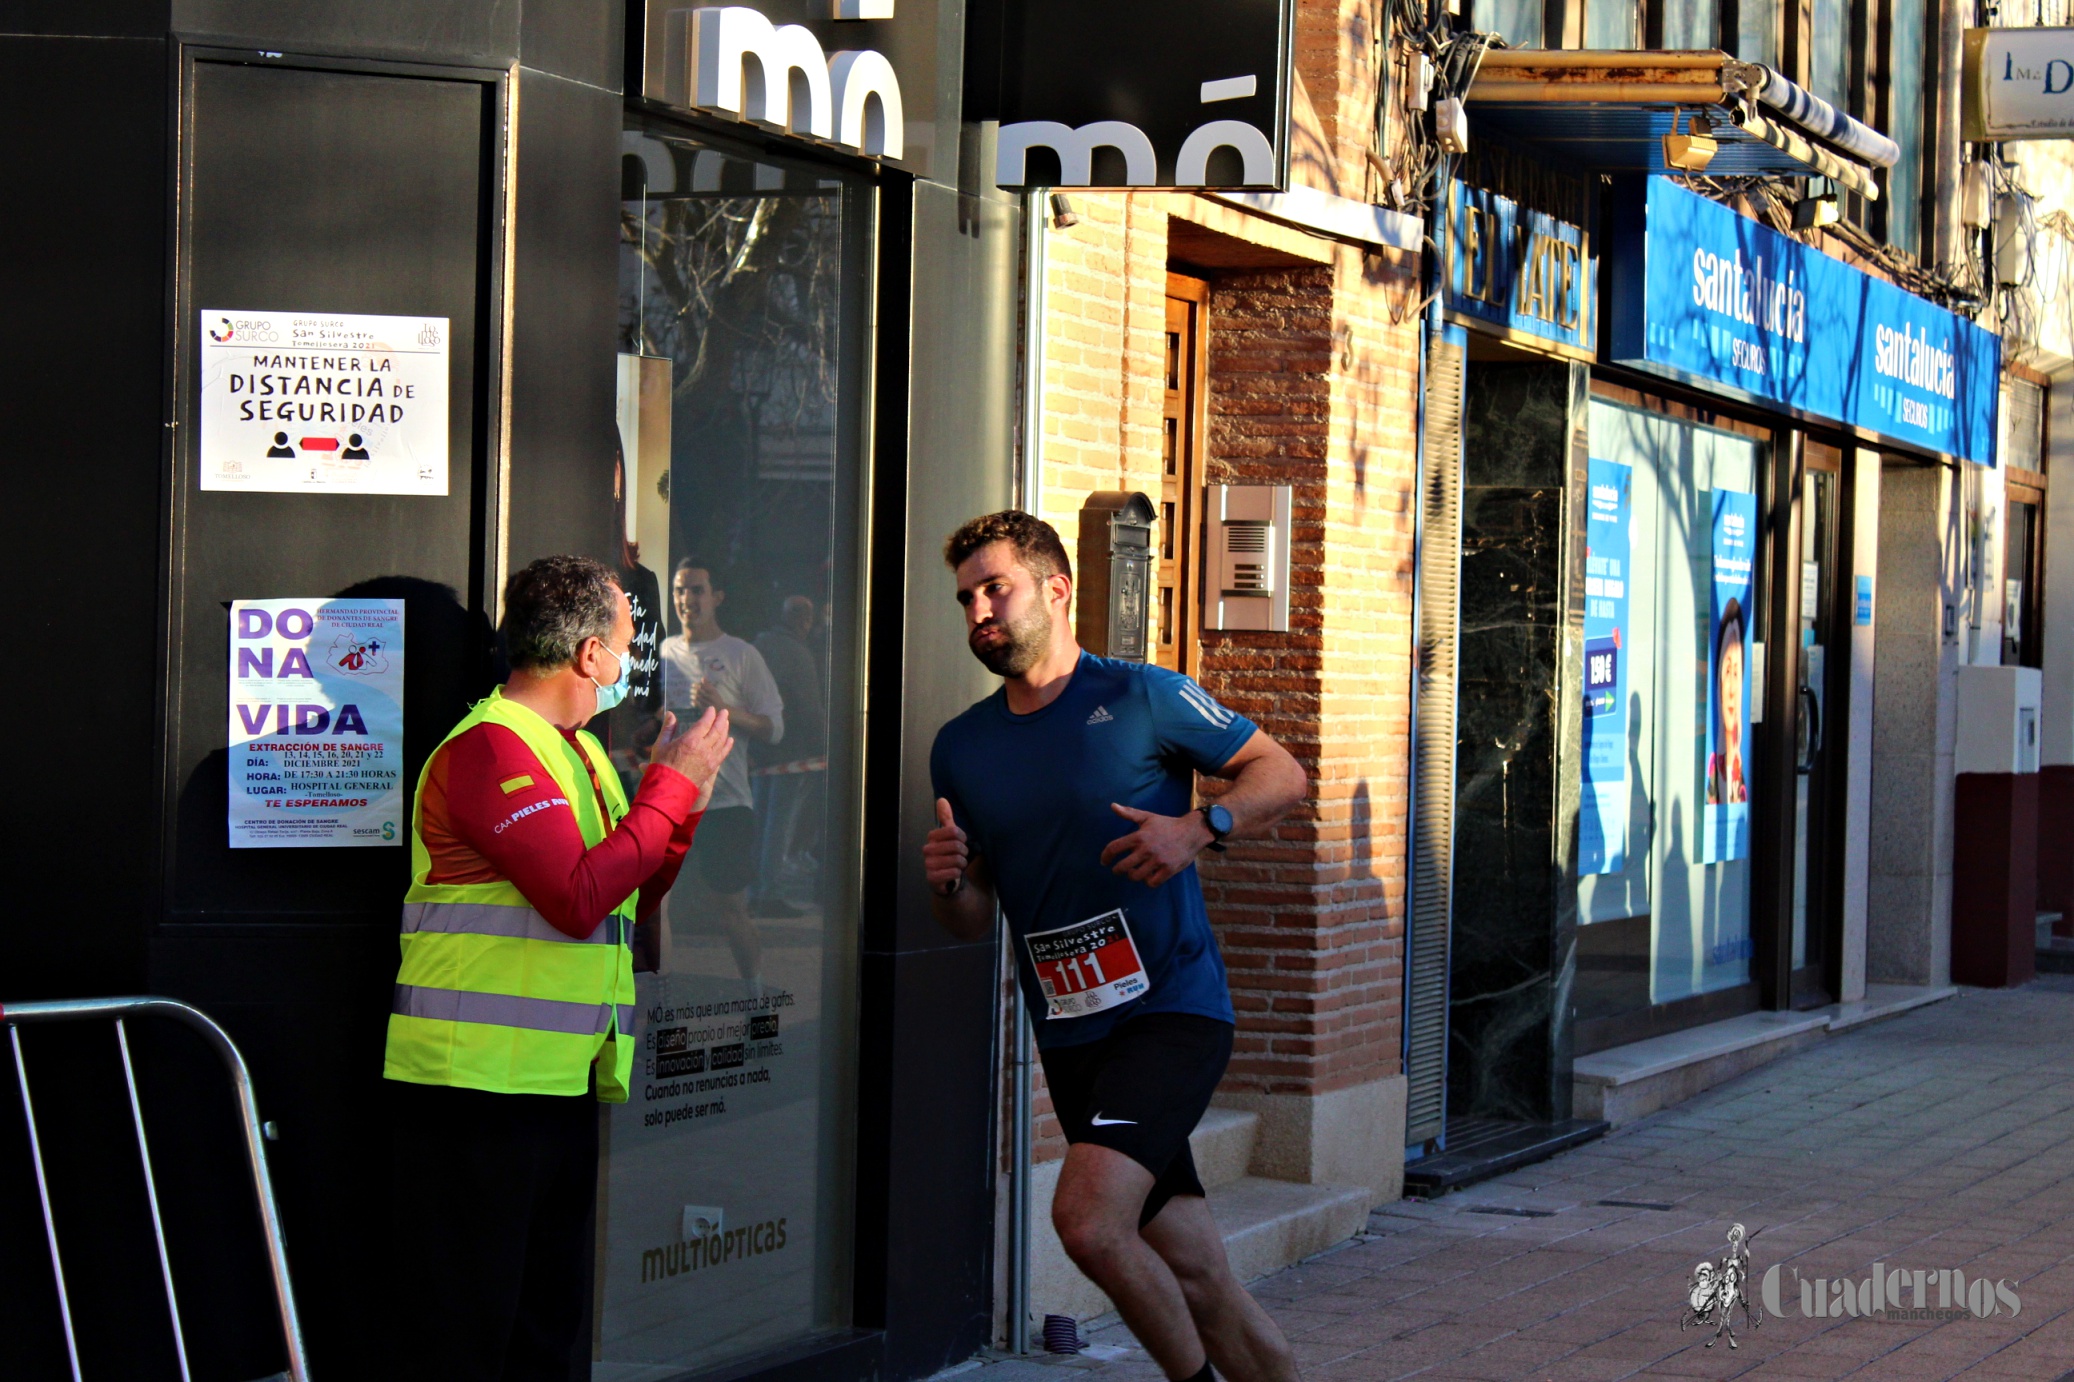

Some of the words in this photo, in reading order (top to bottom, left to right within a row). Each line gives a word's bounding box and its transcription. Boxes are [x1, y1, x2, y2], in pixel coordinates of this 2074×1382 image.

[1462, 205, 1506, 309] EL
[1513, 224, 1580, 331] YATE
[1692, 247, 1805, 344] santalucía
[235, 320, 271, 331] GRUPO
[235, 330, 280, 343] SURCO
[292, 328, 314, 338] San
[319, 329, 375, 340] Silvestre
[292, 340, 349, 349] Tomellosera
[352, 342, 376, 350] 2021
[1732, 337, 1767, 376] SEGUROS
[253, 355, 361, 371] MANTENER
[370, 358, 392, 372] LA
[1874, 321, 1955, 400] santalucía
[230, 374, 384, 397] DISTANCIA
[393, 384, 416, 399] DE
[240, 400, 404, 423] SEGURIDAD
[1902, 397, 1929, 429] SEGUROS
[238, 608, 314, 640] DO
[238, 647, 314, 679] NA
[236, 704, 369, 736] VIDA
[1086, 714, 1114, 726] adidas
[249, 742, 320, 752] EXTRACCIÓN
[323, 743, 337, 751] DE
[340, 743, 384, 751] SANGRE
[366, 752, 371, 761] y
[374, 751, 384, 759] 22
[246, 757, 269, 767] DÍA:
[284, 759, 340, 768] DICIEMBRE
[342, 759, 361, 768] 2021
[284, 771, 298, 779] DE
[301, 771, 324, 779] 17:30
[325, 771, 333, 779] A
[335, 771, 359, 779] 21:30
[361, 770, 397, 779] HORAS
[246, 772, 281, 781] HORA:
[291, 782, 342, 791] HOSPITAL
[344, 782, 394, 790] GENERAL
[246, 786, 287, 795] LUGAR:
[265, 799, 281, 807] TE
[285, 798, 368, 807] ESPERAMOS
[494, 818, 513, 834] CAA
[511, 800, 551, 822] PIELES
[1033, 942, 1052, 954] San
[1053, 925, 1116, 950] Silvestre
[1036, 944, 1087, 963] Tomellosera
[1089, 934, 1121, 950] 2021
[1055, 952, 1107, 993] 111
[1113, 977, 1138, 991] Pieles
[647, 1006, 663, 1024] MÓ
[664, 1008, 675, 1022] es
[676, 1002, 695, 1021] más
[696, 1003, 712, 1022] que
[714, 1002, 730, 1015] una
[731, 998, 758, 1013] marca
[760, 993, 770, 1010] de
[771, 990, 796, 1012] gafas.
[646, 1032, 656, 1050] Es
[658, 1029, 687, 1050] diseño
[688, 1025, 716, 1046] propio
[716, 1023, 726, 1040] al
[726, 1020, 750, 1041] mejor
[646, 1059, 656, 1076] Es
[656, 1051, 704, 1076] innovación
[711, 1046, 743, 1068] calidad
[744, 1045, 756, 1061] sin
[645, 1080, 680, 1101] Cuando
[682, 1083, 694, 1096] no
[695, 1071, 738, 1093] renuncias
[739, 1074, 745, 1085] a
[746, 1066, 771, 1084] nada,
[644, 1109, 663, 1127] solo
[665, 1103, 694, 1128] puede
[695, 1100, 709, 1118] ser
[710, 1096, 726, 1115] mó.
